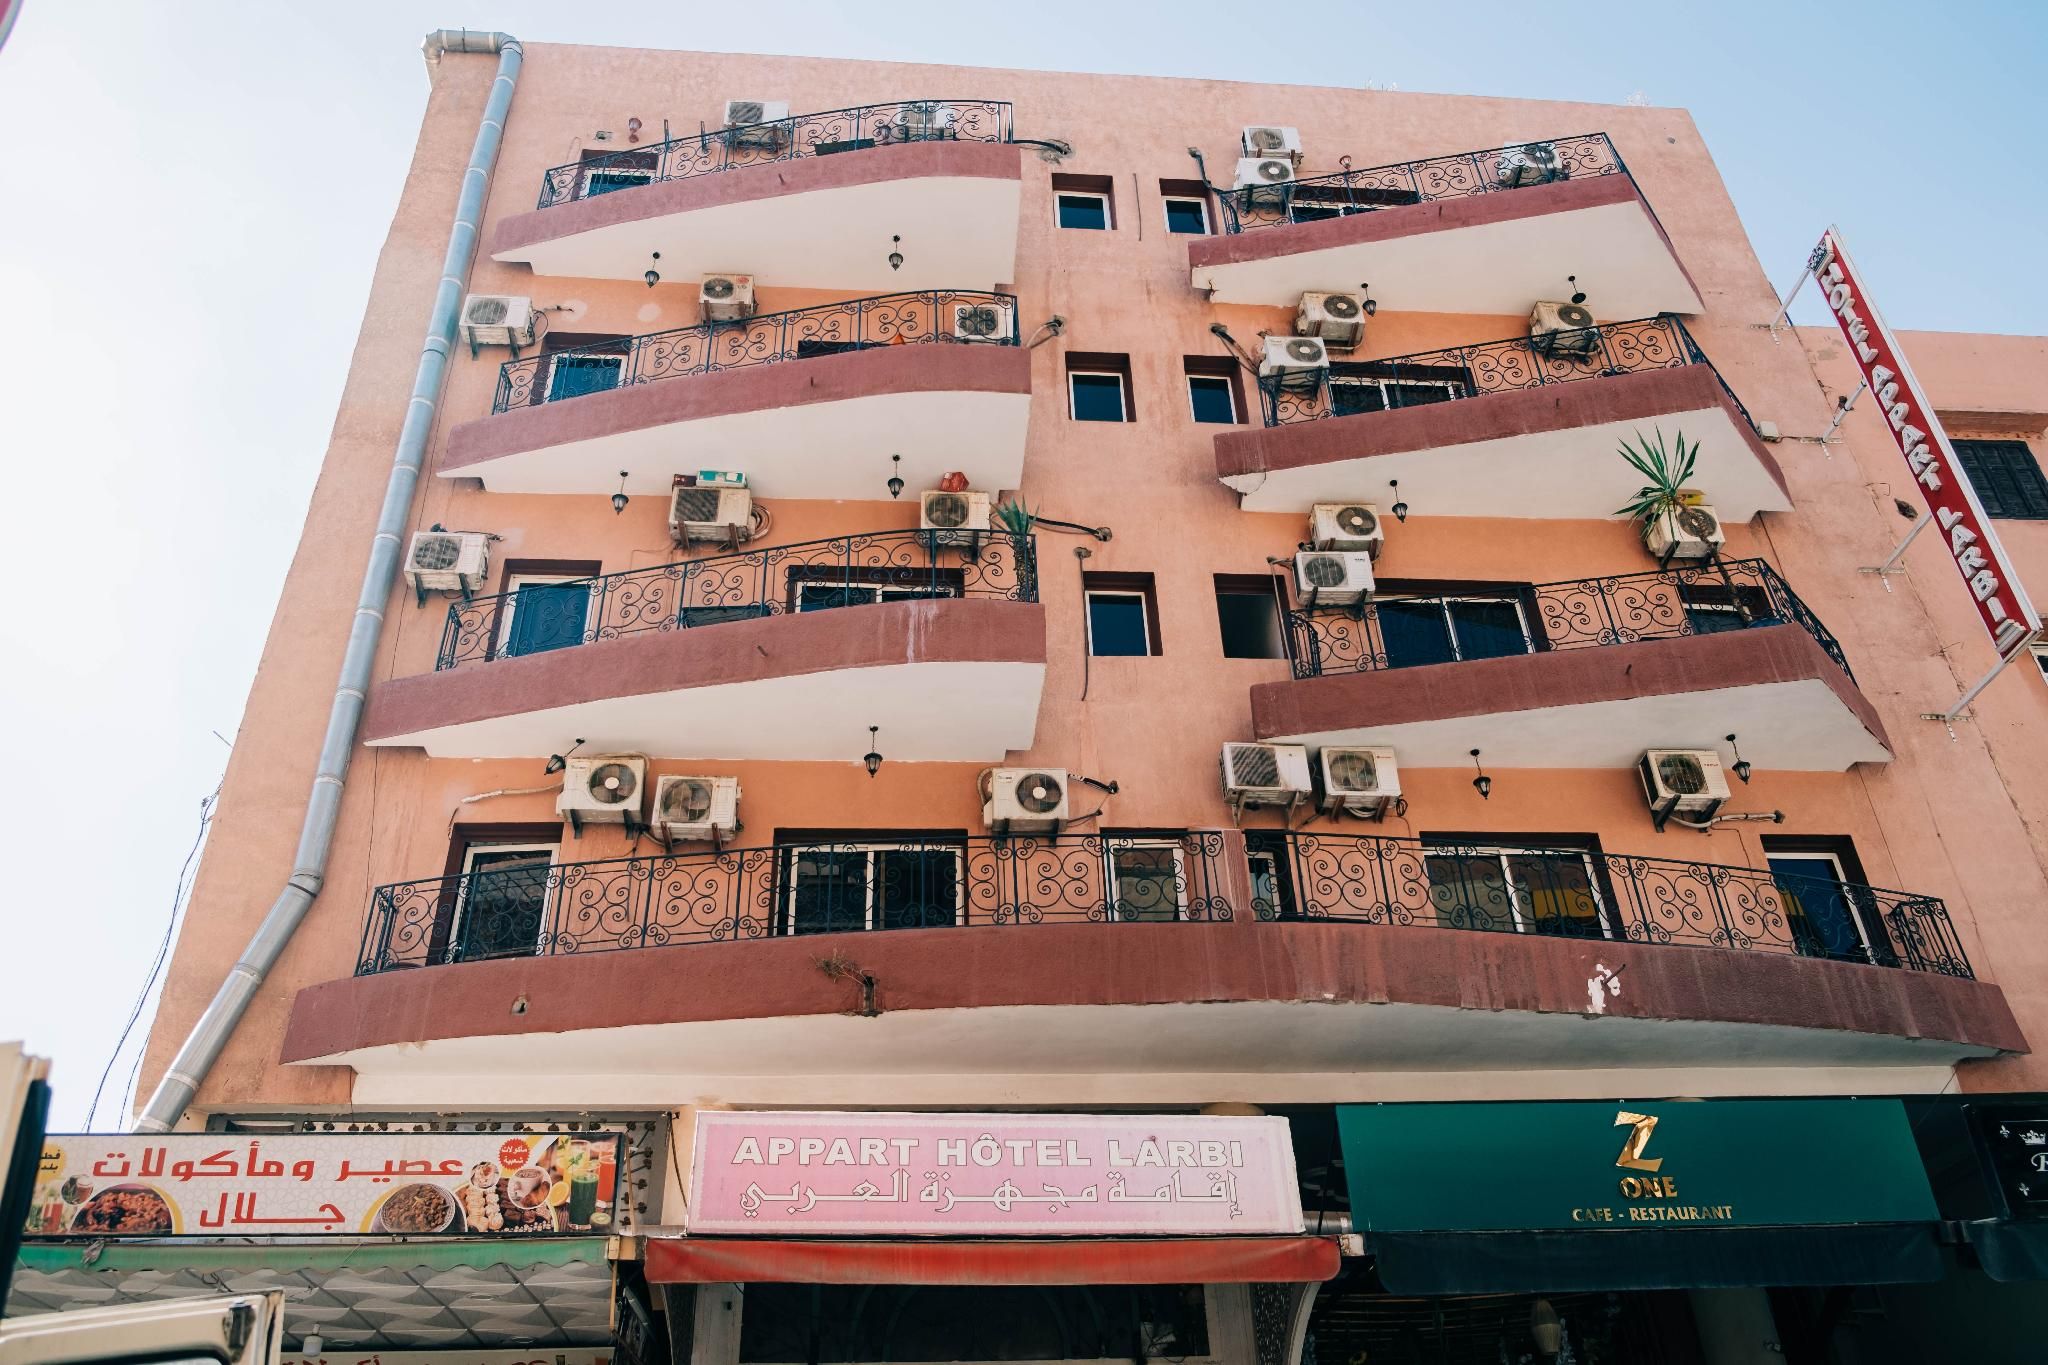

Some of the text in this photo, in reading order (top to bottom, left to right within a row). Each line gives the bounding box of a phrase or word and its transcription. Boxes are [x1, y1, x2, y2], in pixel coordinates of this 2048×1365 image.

[1820, 262, 2007, 622] HOTEL APPART LARBI
[92, 1140, 464, 1183] عصير ومأكولات
[731, 1132, 1244, 1168] APPART HÔTEL LARBI
[1613, 1111, 1663, 1172] Z
[740, 1168, 1243, 1219] إقامة مجهزة العربي
[1620, 1176, 1678, 1199] ONE
[200, 1191, 346, 1231] جلال
[1572, 1207, 1613, 1222] CAFE
[1629, 1205, 1733, 1221] RESTAURANT
